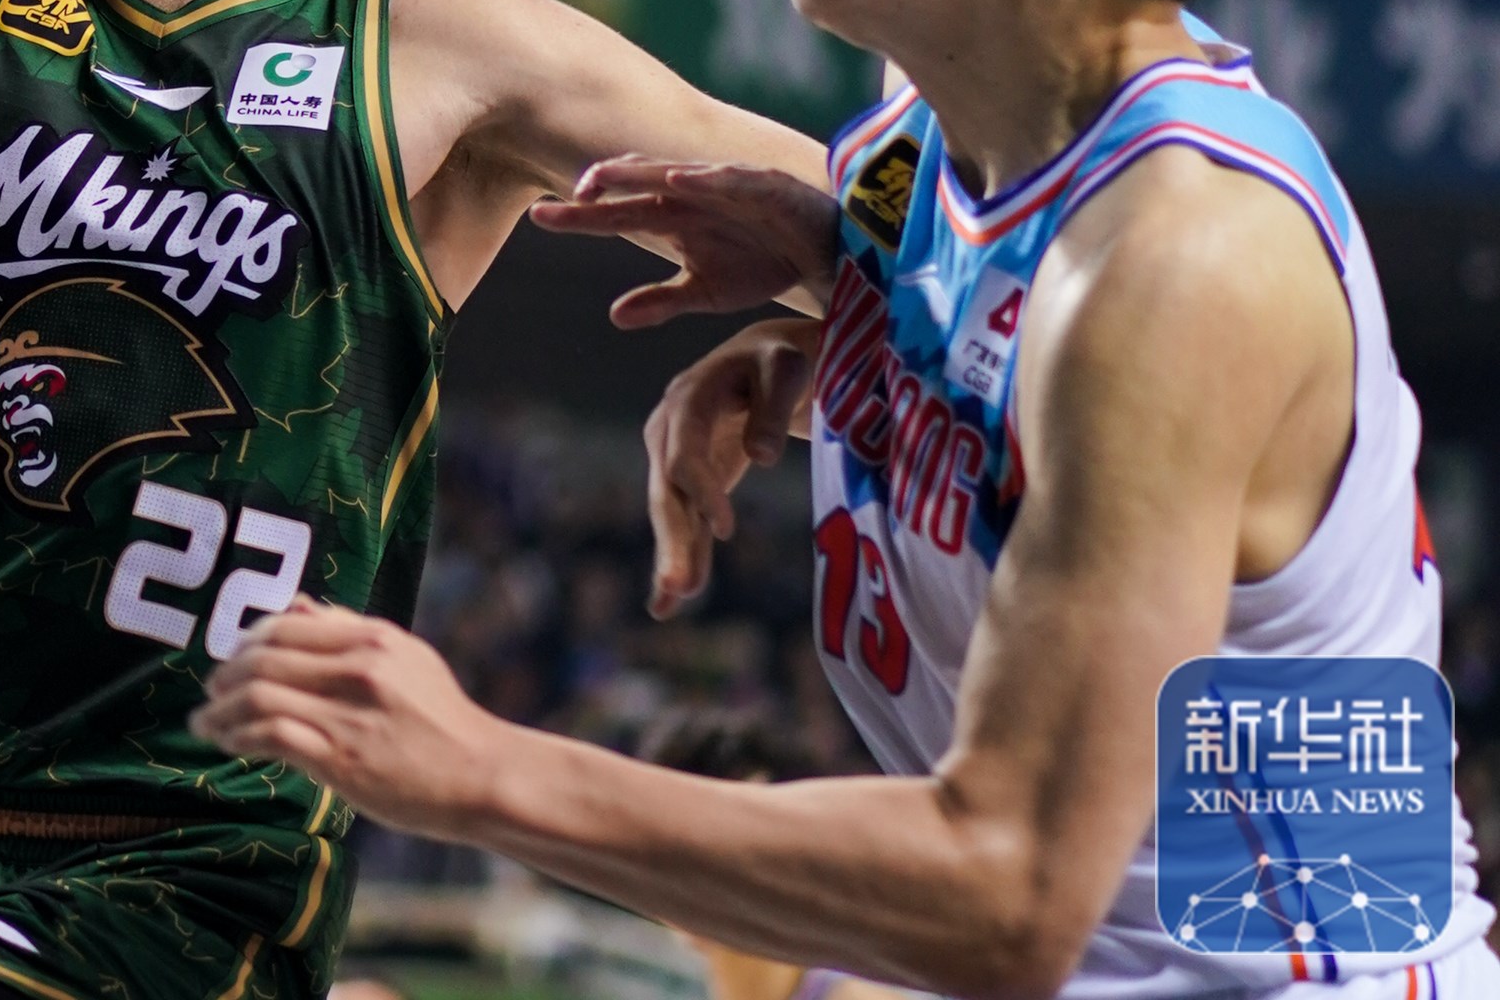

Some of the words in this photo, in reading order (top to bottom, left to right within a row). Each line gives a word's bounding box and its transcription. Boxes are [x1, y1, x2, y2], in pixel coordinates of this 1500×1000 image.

[25, 8, 70, 35] CBA
[237, 107, 282, 116] CHINA
[287, 109, 319, 119] LIFE
[240, 93, 323, 109] 中国人寿
[103, 479, 312, 662] 22
[815, 505, 910, 697] 13
